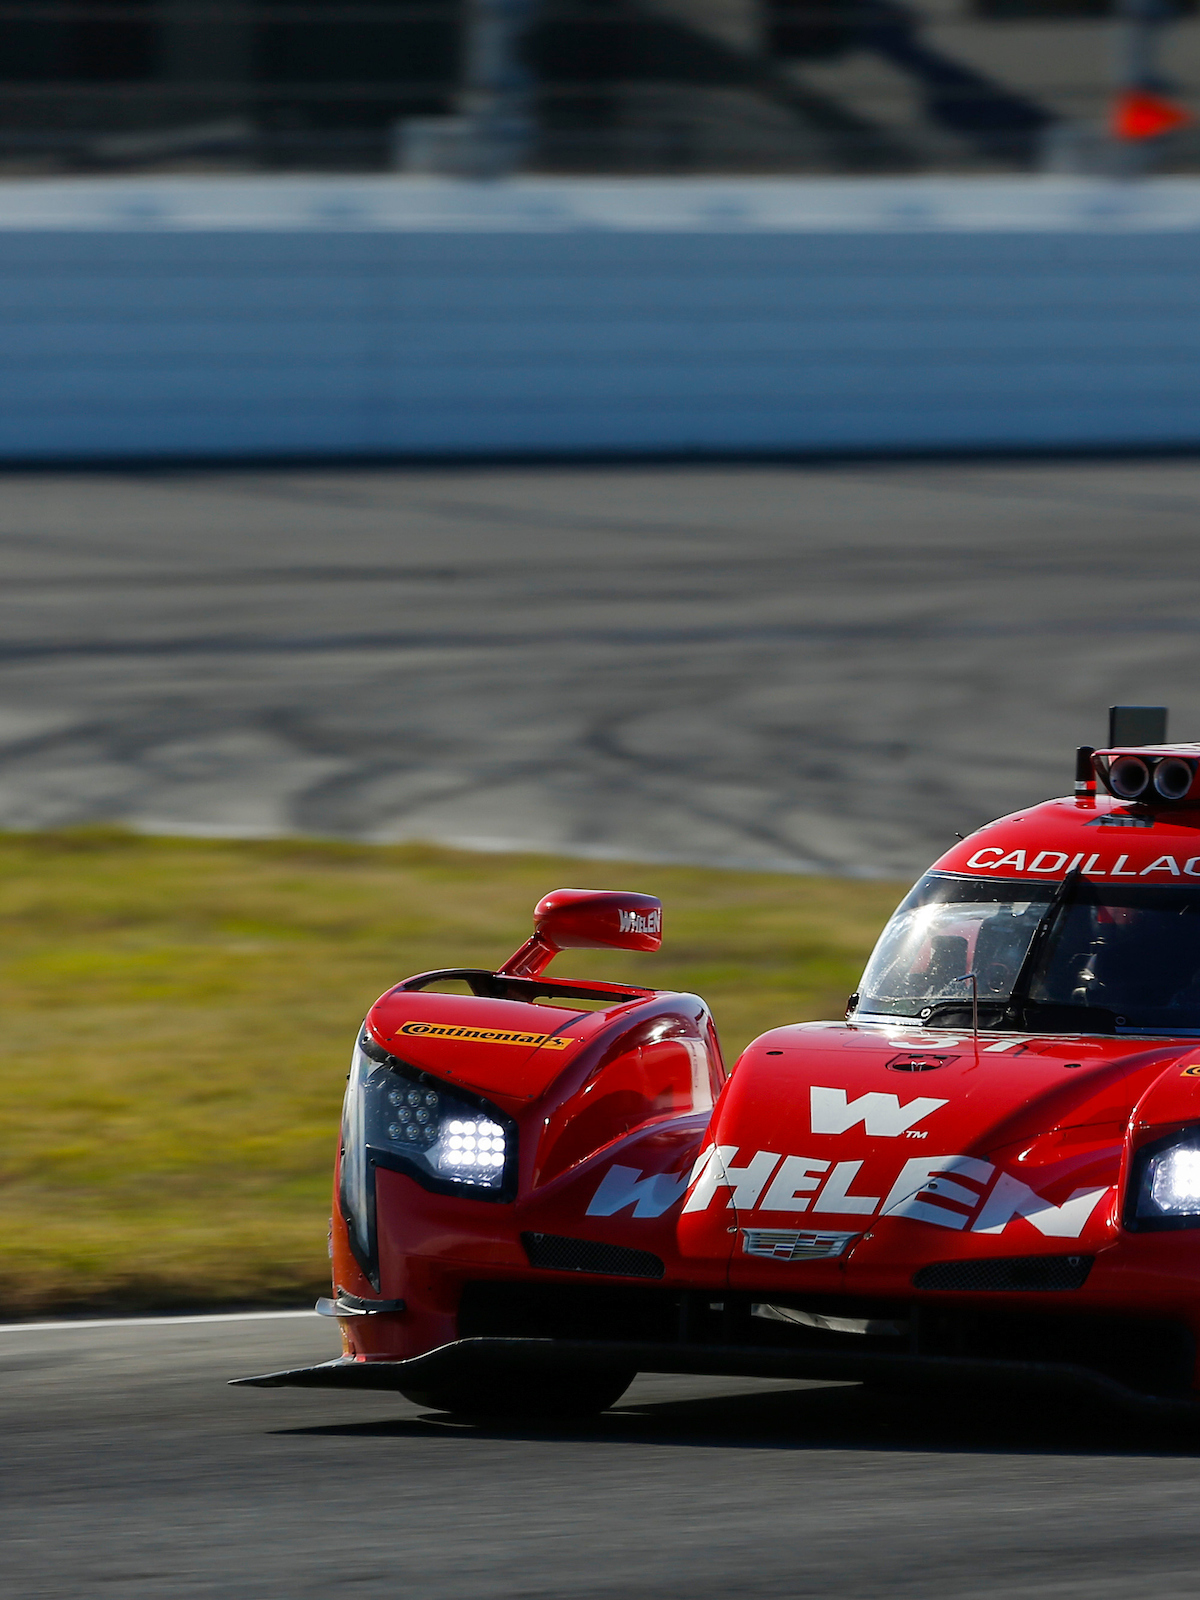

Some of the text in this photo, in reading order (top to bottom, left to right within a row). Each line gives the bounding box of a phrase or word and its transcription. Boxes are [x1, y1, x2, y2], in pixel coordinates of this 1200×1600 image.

[618, 908, 660, 933] WHELEN
[402, 1023, 545, 1044] Continental
[585, 1143, 1110, 1238] WHELEN
